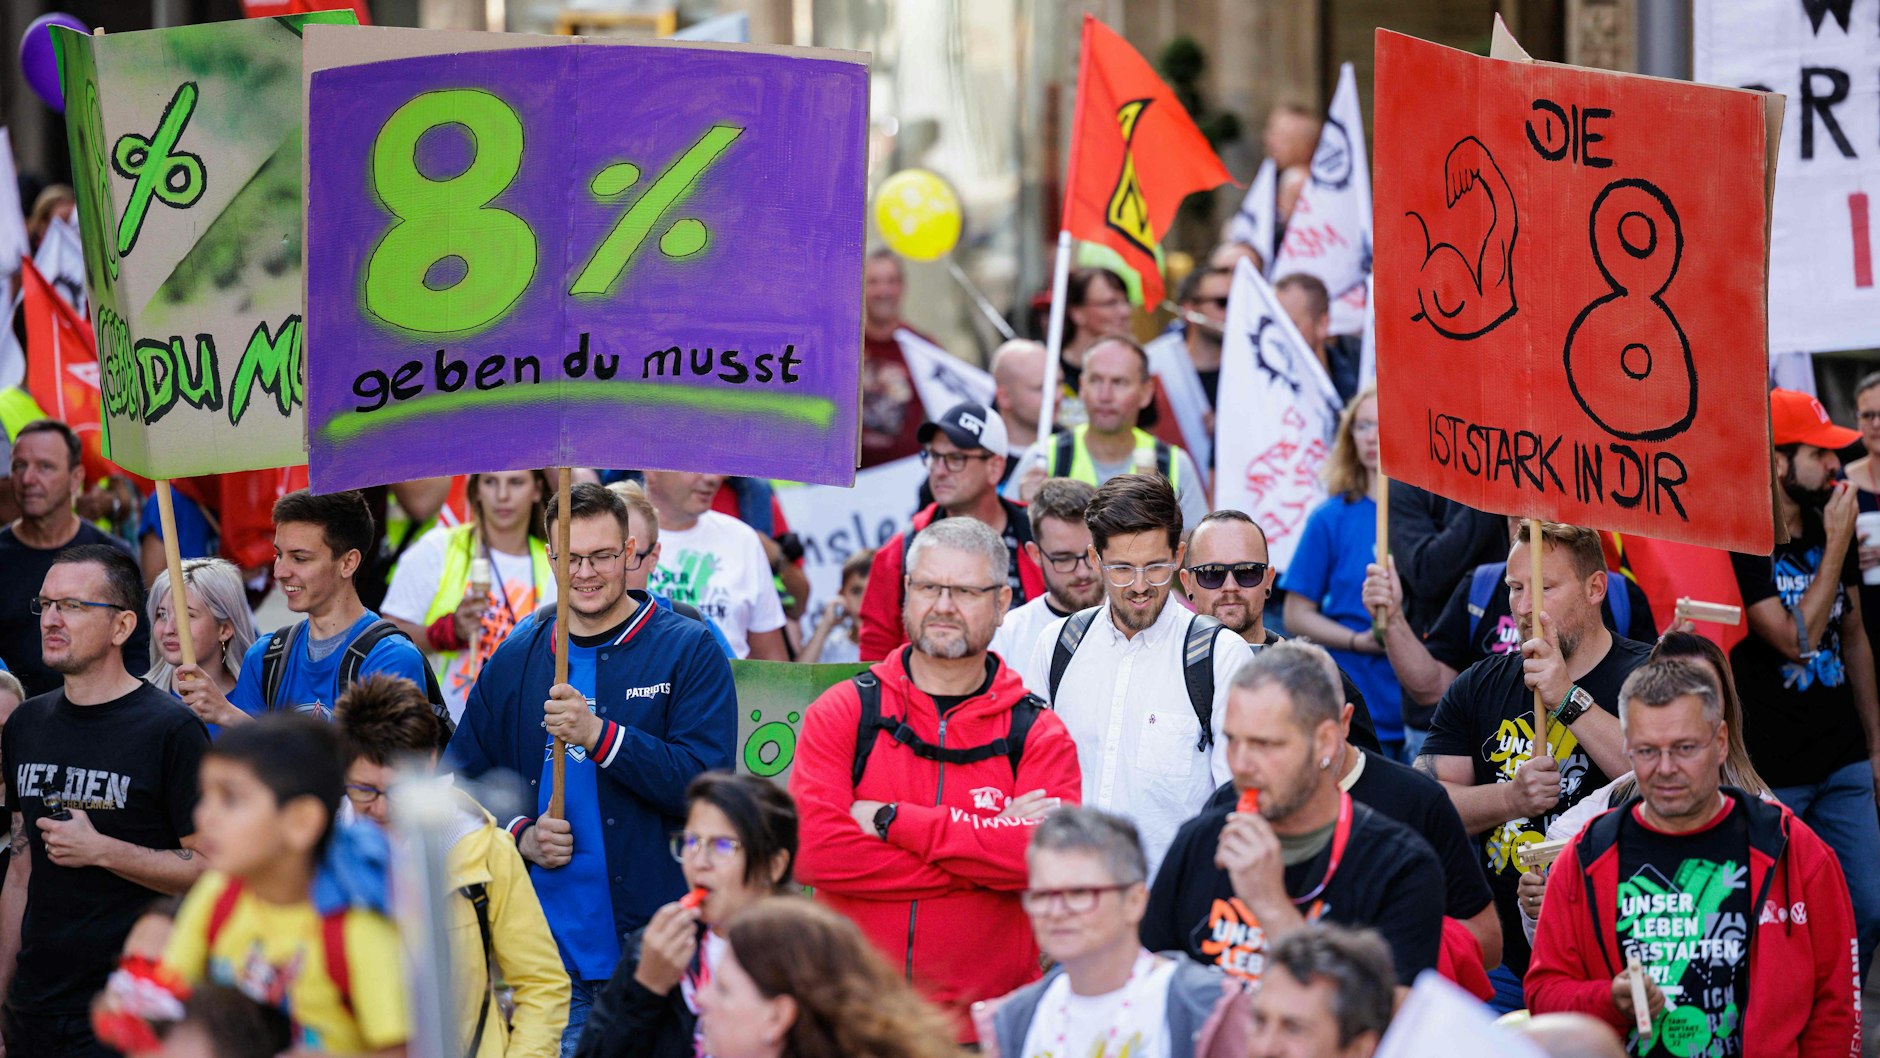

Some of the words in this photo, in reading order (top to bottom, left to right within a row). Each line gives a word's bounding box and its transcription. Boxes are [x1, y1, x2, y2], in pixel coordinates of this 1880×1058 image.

[1525, 99, 1613, 168] DIE
[366, 89, 537, 333] 8
[568, 125, 747, 296] %
[1563, 177, 1699, 442] 8
[134, 333, 224, 427] DU
[352, 349, 541, 413] geben
[563, 332, 620, 380] du
[642, 344, 802, 384] musst
[1428, 408, 1465, 470] IST
[1461, 423, 1567, 495] STARK
[1574, 440, 1603, 504] IN
[1609, 442, 1690, 523] DIR
[626, 682, 671, 700] PATRIOTS
[1621, 893, 1694, 916] UNSER
[1633, 916, 1699, 939] LEBEN
[1625, 939, 1739, 963] GESTALTEN
